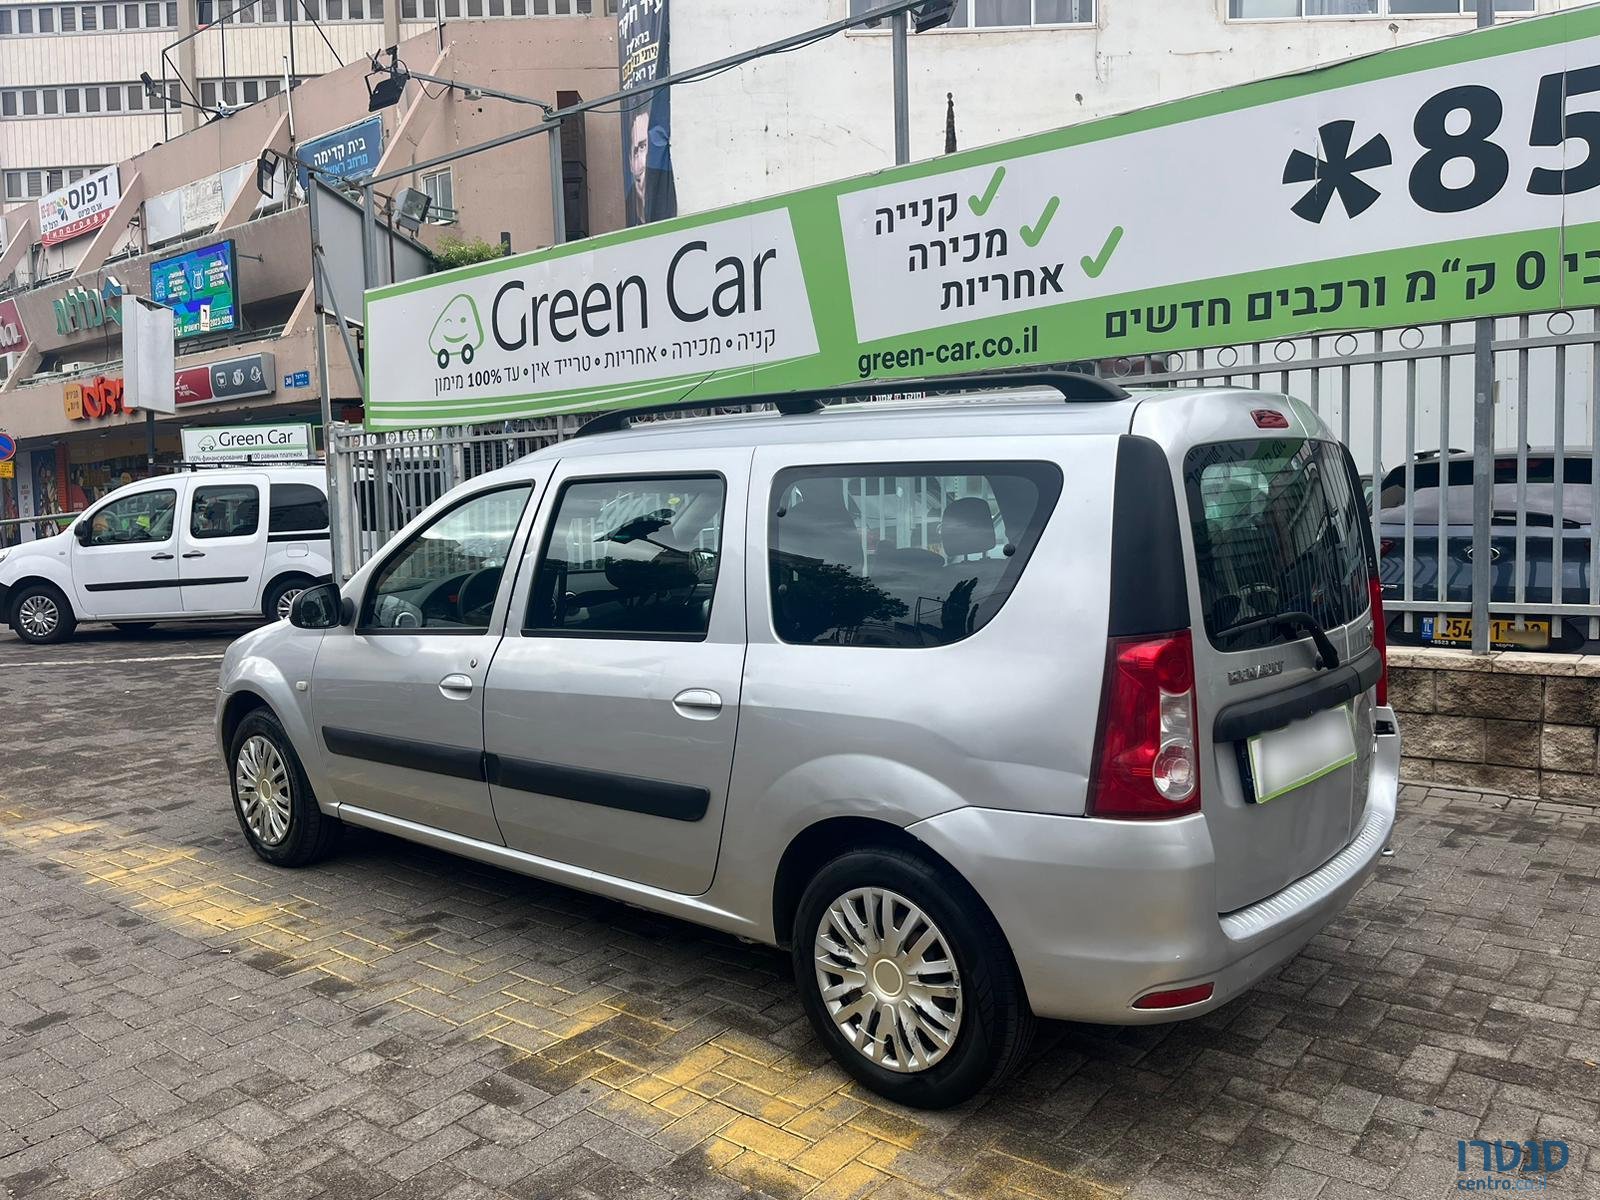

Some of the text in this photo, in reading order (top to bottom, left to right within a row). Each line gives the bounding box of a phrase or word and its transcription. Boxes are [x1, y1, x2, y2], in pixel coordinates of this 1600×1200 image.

[348, 138, 367, 155] בית
[68, 175, 108, 210] דפוס
[875, 193, 958, 236] קנייה
[909, 228, 1008, 272] מכירה
[1516, 250, 1546, 291] 0
[491, 240, 777, 352] Green Car
[940, 263, 1065, 311] אחריות
[1247, 276, 1386, 322] ורכבים
[1105, 297, 1232, 339] חדשים
[434, 329, 776, 397] קניה מכירה אחריות טרייד אין עד 100% מימון
[858, 325, 1038, 379] green-car.co.il
[218, 430, 293, 447] Green Car
